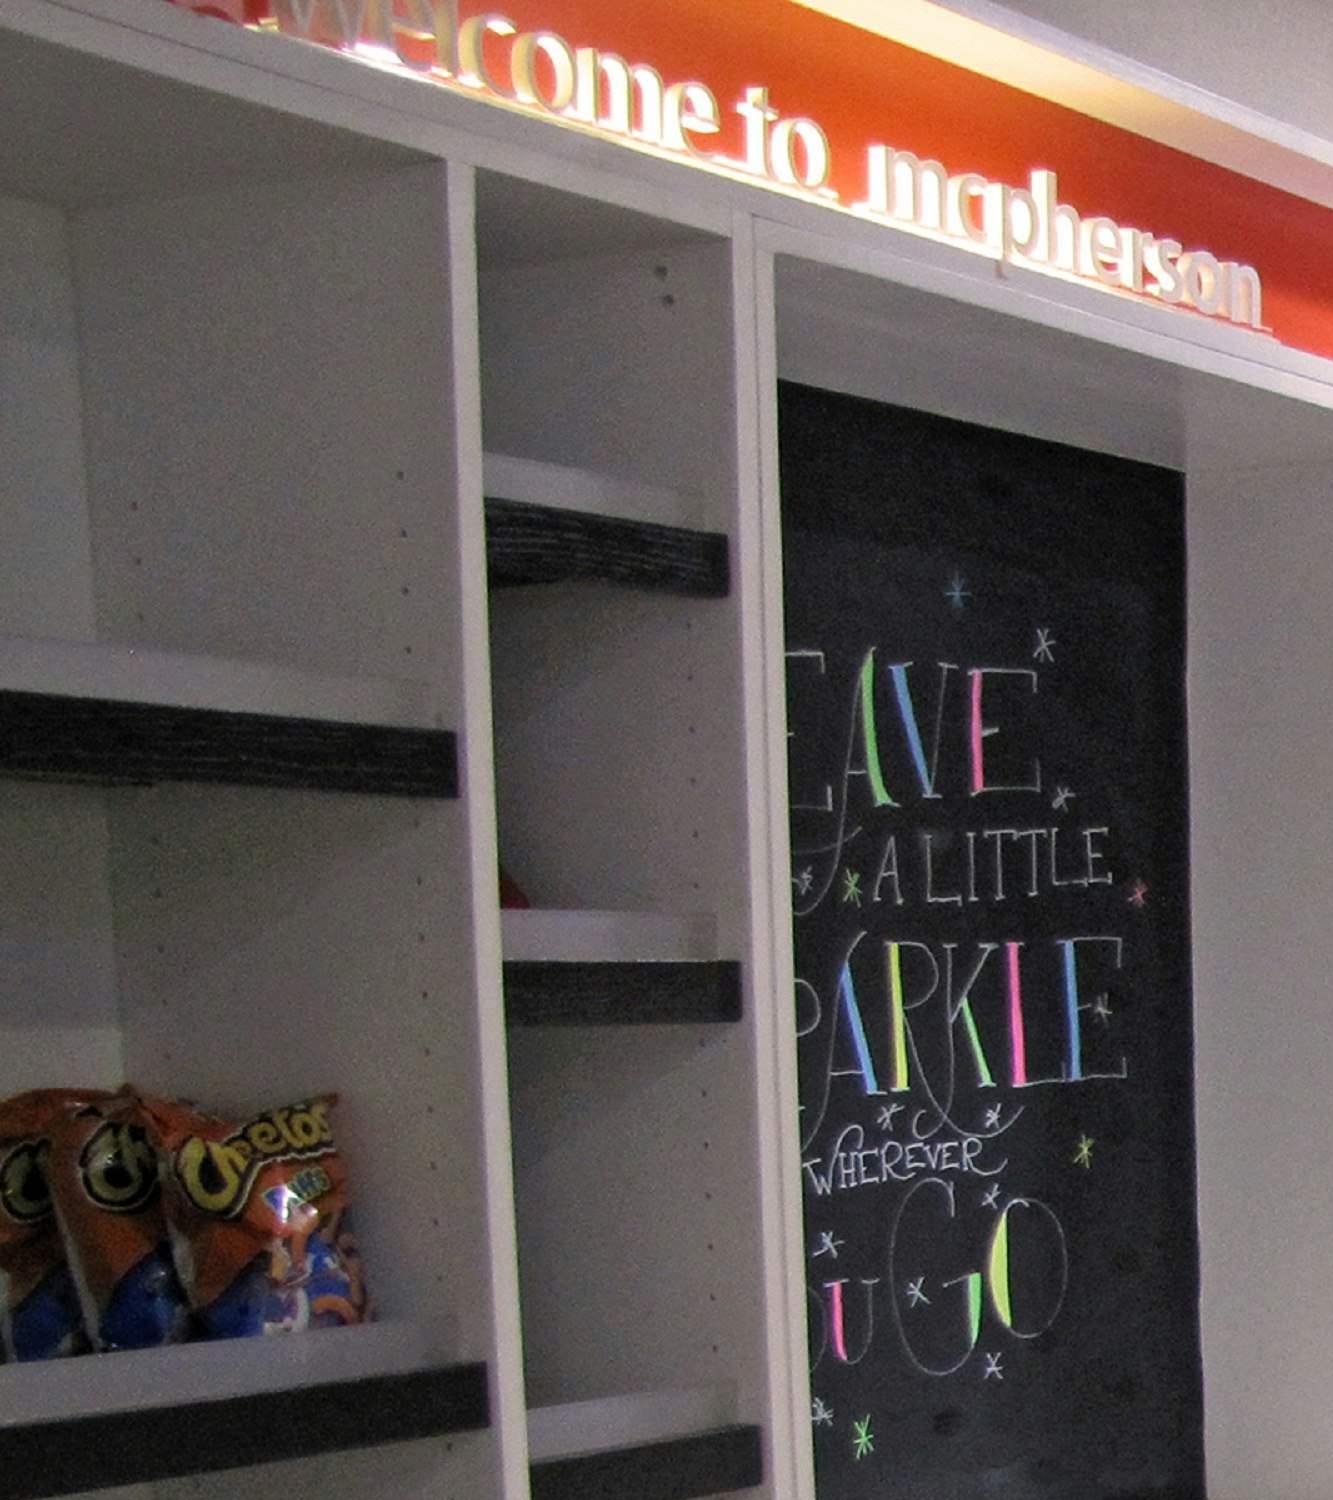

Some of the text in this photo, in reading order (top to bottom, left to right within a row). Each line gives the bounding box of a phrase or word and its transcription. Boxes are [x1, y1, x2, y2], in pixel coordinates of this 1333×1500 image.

[742, 86, 836, 190] to
[866, 141, 1267, 329] mcpherson
[871, 827, 1112, 906] A LITTLE
[802, 1125, 1009, 1196] WHEREVER
